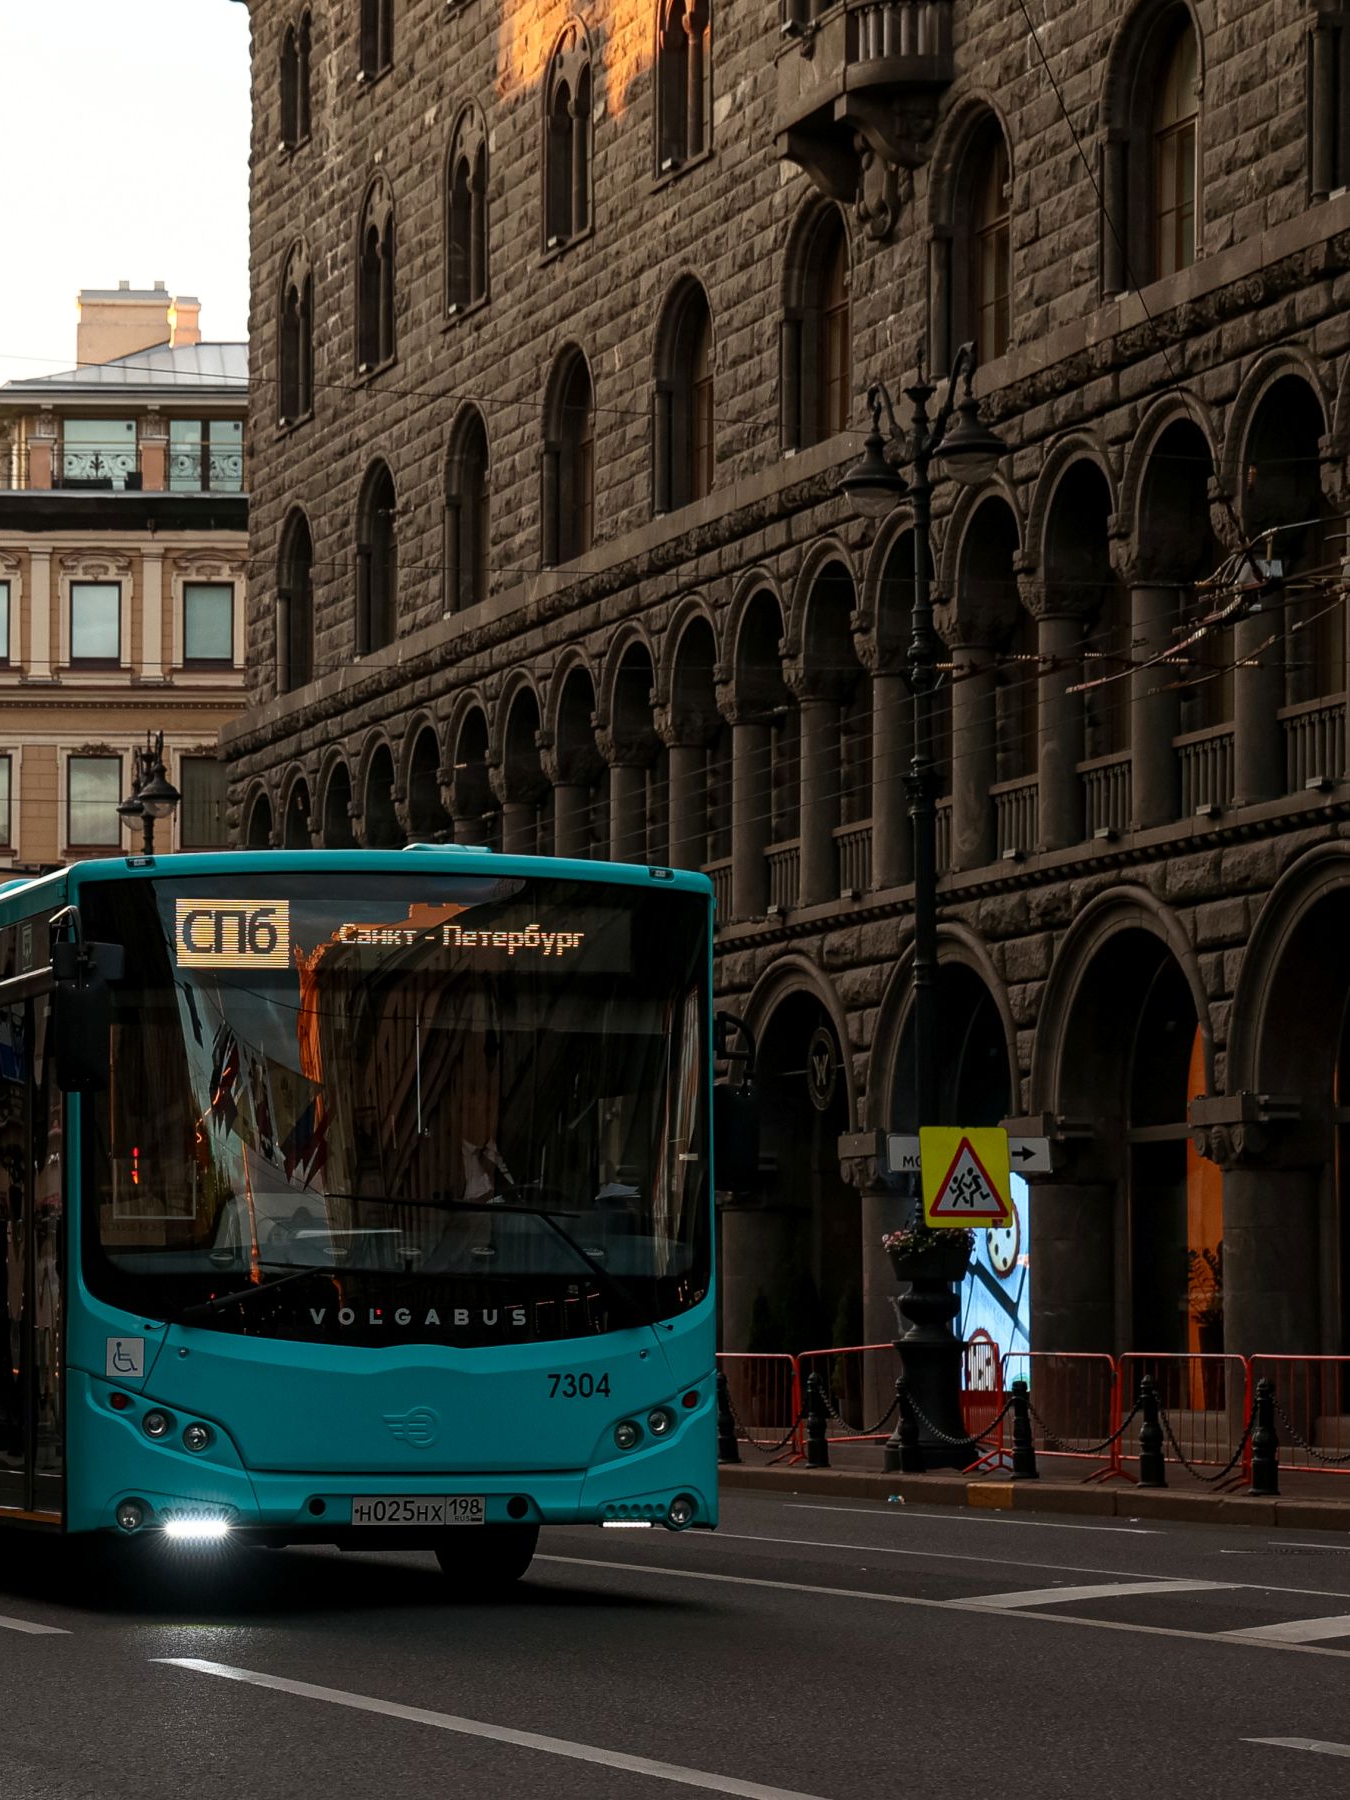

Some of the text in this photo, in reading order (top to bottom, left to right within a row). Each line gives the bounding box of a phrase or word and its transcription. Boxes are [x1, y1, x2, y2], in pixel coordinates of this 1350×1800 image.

[182, 907, 278, 954] СПб
[338, 923, 417, 945] Санкт
[442, 923, 586, 956] Петербург
[309, 1308, 527, 1326] VOLGABUS
[547, 1373, 611, 1398] 7304
[448, 1498, 480, 1516] 198
